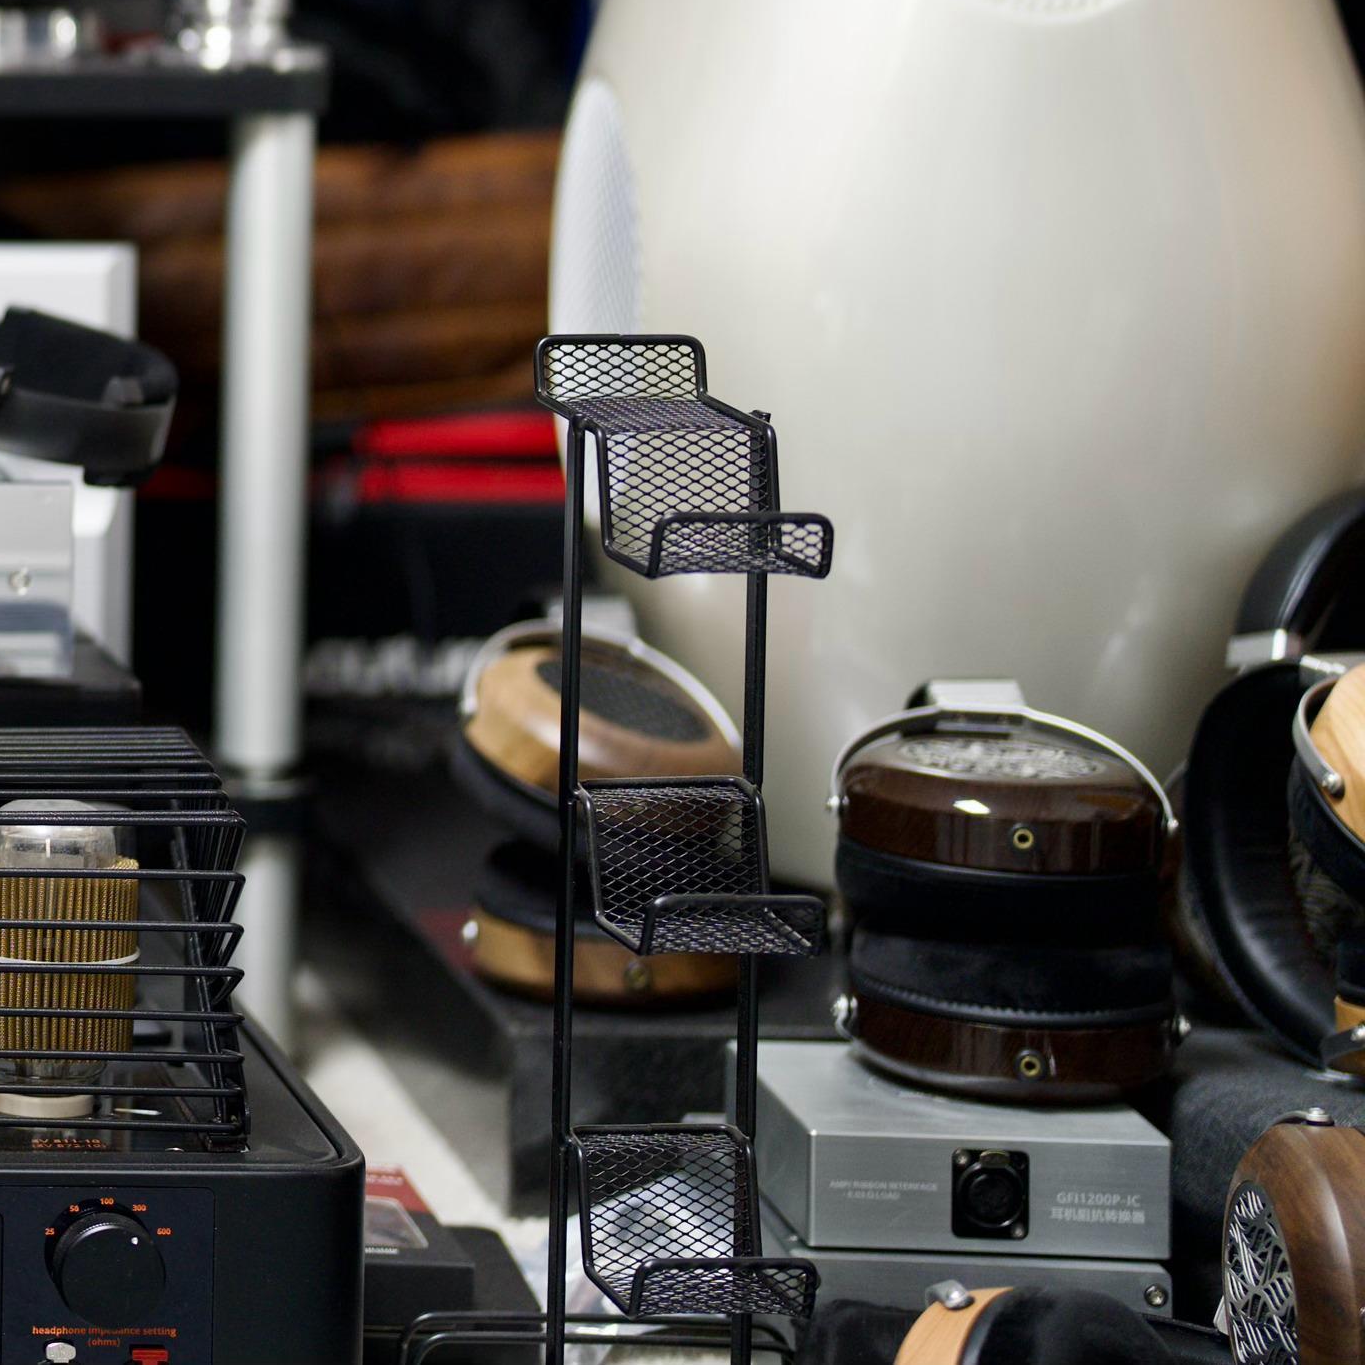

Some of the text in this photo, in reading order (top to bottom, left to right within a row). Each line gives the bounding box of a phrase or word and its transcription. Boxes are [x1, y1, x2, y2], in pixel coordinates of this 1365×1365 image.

[100, 1197, 115, 1205] 100
[69, 1204, 80, 1212] 50
[132, 1204, 147, 1212] 300
[44, 1227, 55, 1235] 25
[156, 1227, 172, 1235] 600
[31, 1325, 87, 1337] headphone
